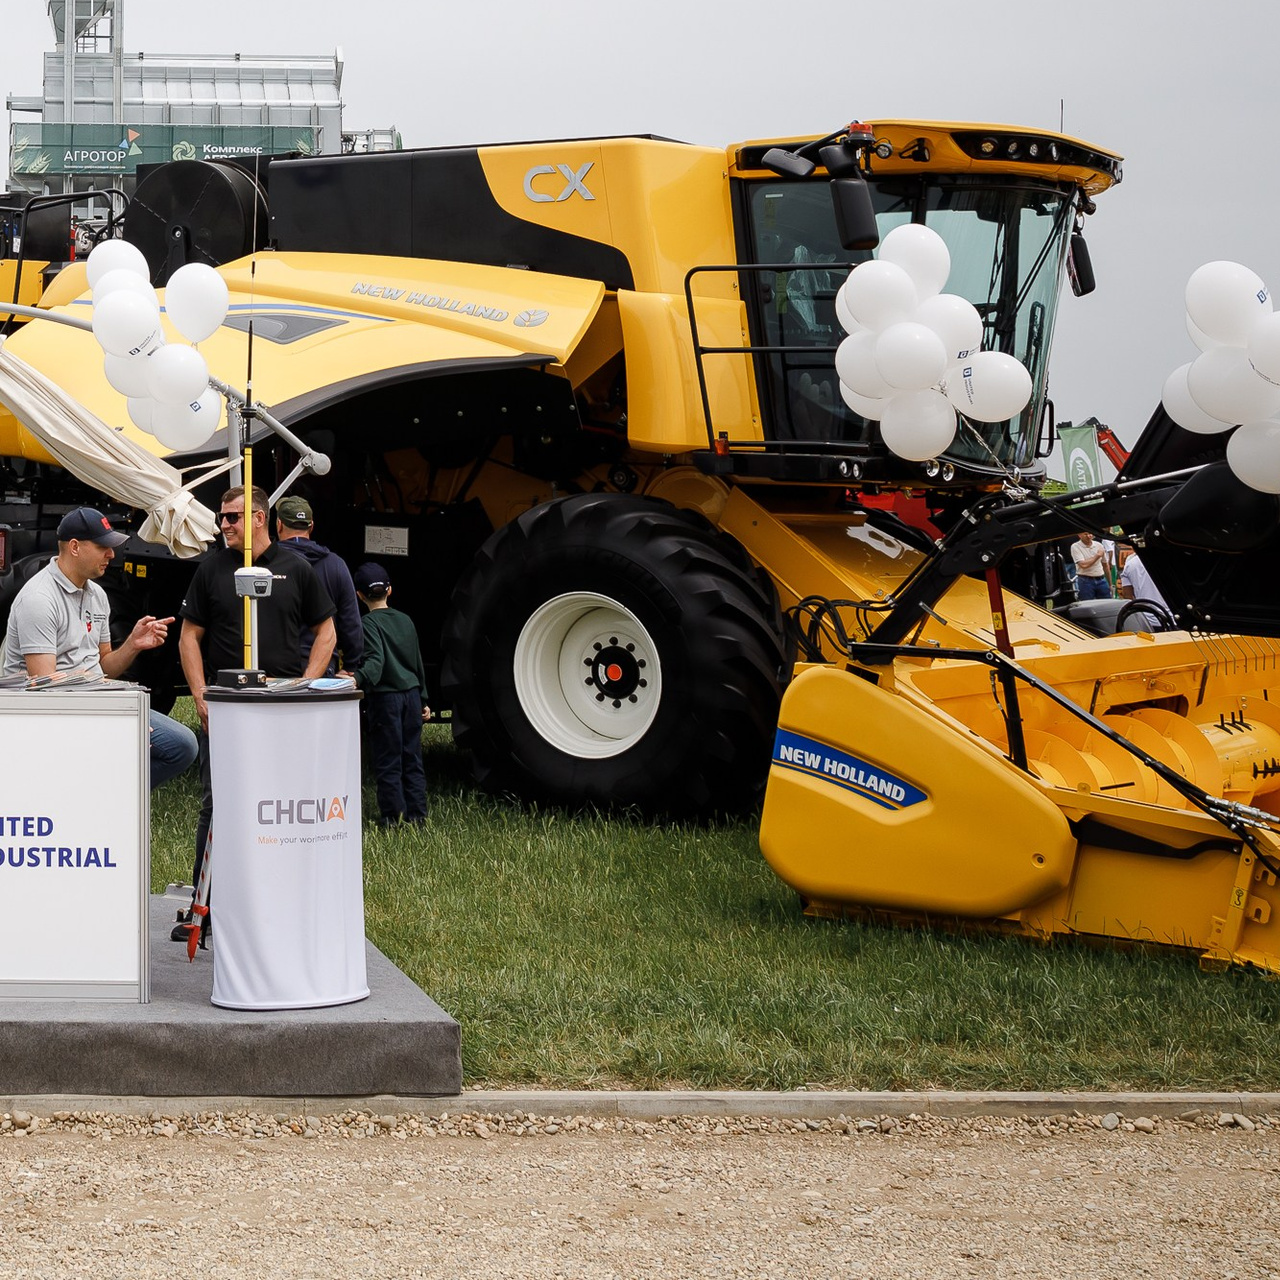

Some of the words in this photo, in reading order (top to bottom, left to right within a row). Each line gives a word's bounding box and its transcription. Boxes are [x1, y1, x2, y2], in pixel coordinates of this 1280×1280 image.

[63, 150, 126, 162] АГРОТОР
[202, 144, 263, 154] Комплекс
[523, 162, 596, 203] CX
[351, 282, 407, 301] NEW
[405, 291, 510, 322] HOLLAND
[779, 744, 822, 770] NEW
[823, 757, 906, 802] HOLLAND
[257, 795, 349, 825] CHCNAV
[258, 836, 278, 844] Make
[279, 837, 297, 846] your
